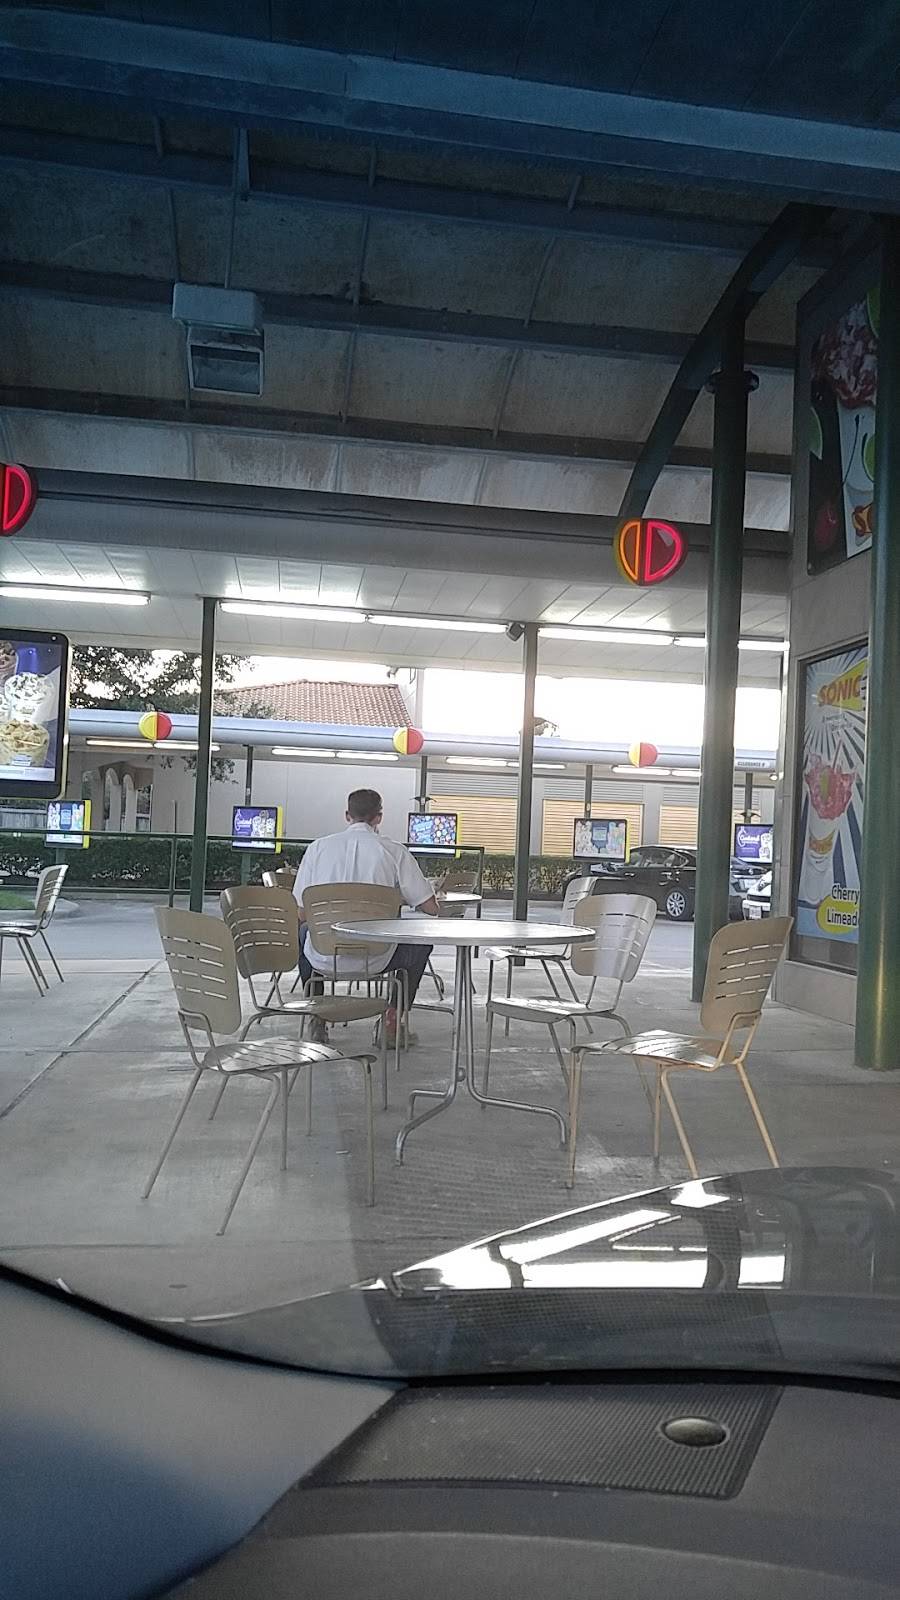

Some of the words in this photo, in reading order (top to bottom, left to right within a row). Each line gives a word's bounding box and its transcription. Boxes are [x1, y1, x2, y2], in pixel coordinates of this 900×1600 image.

[819, 674, 862, 707] SONIC
[831, 884, 860, 905] Cherry
[827, 908, 859, 926] Limead
